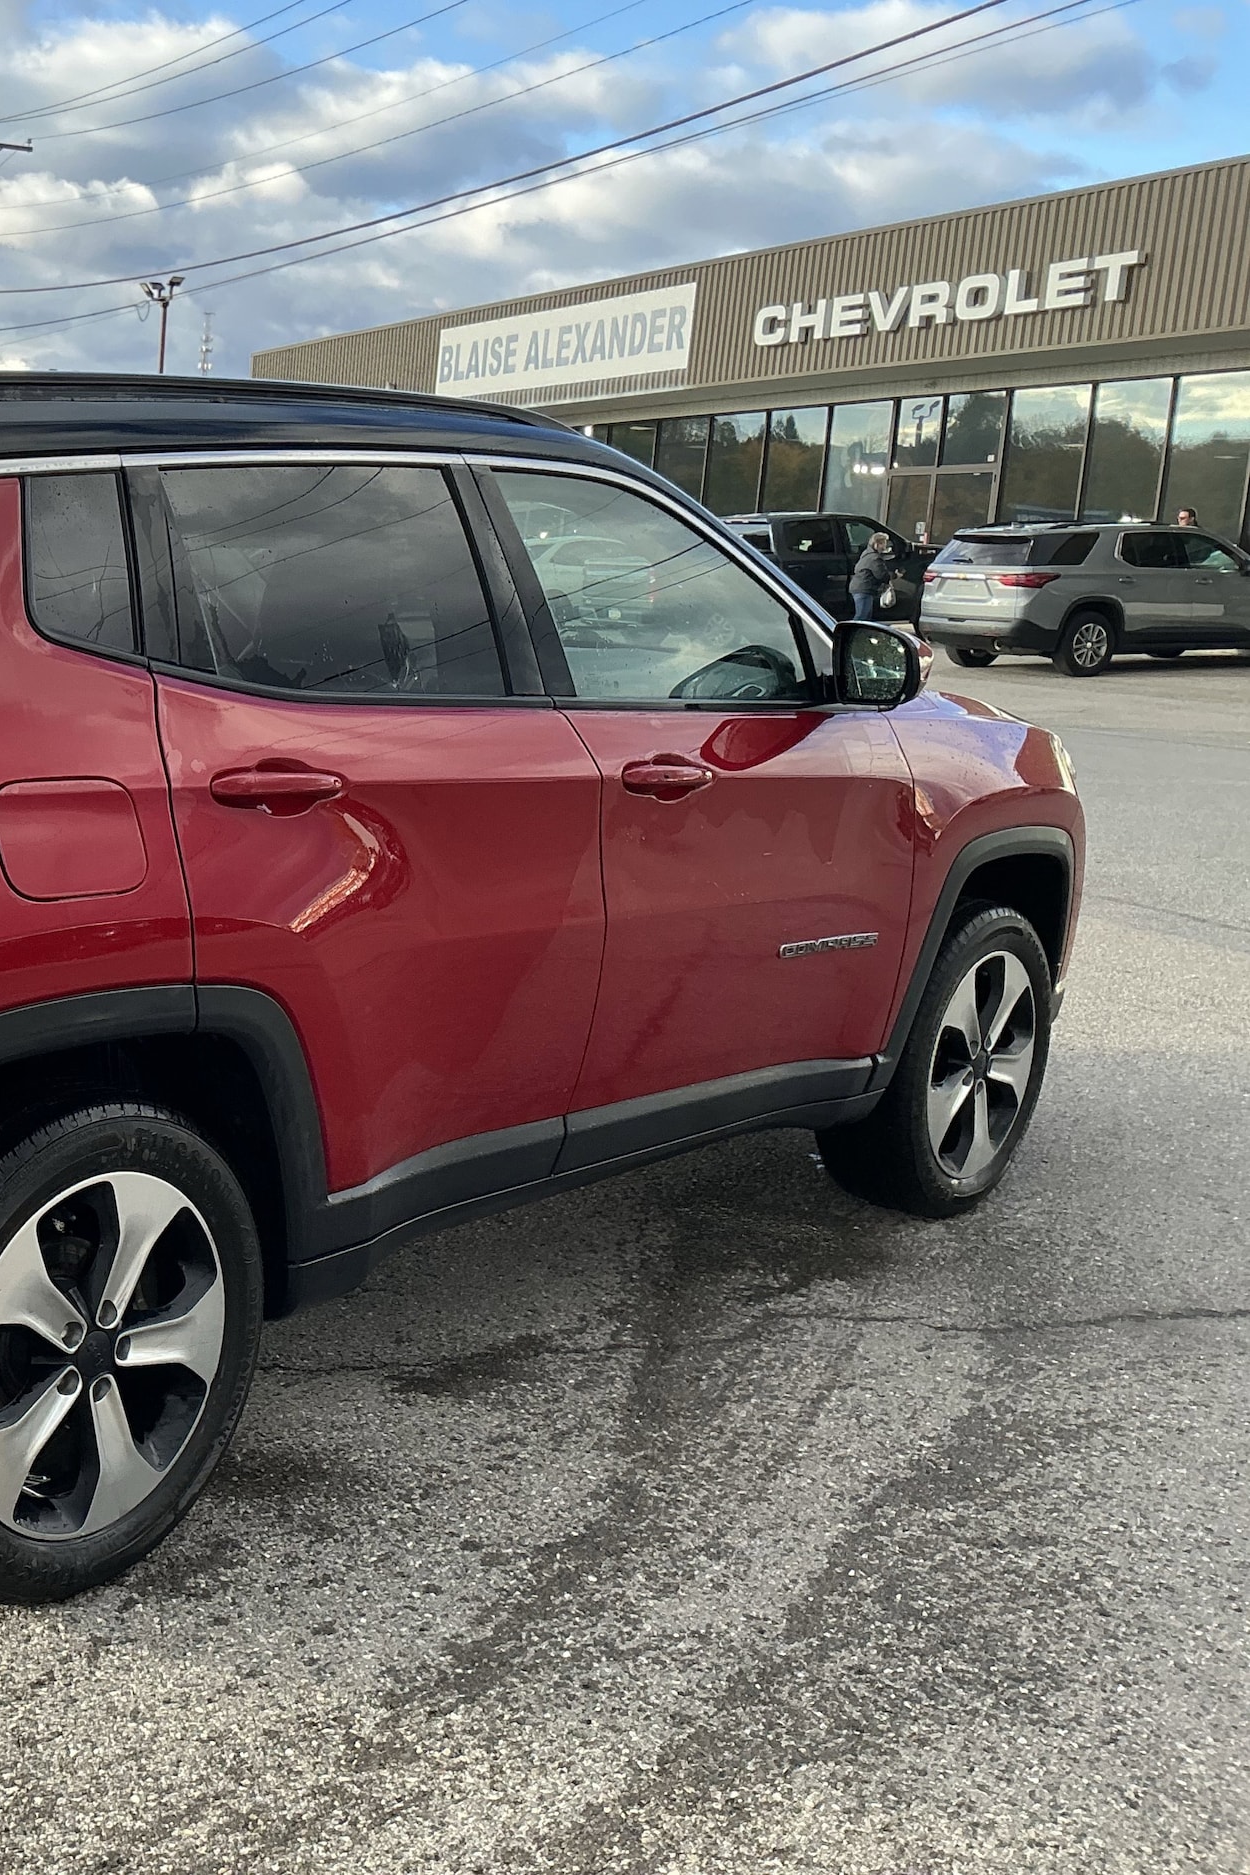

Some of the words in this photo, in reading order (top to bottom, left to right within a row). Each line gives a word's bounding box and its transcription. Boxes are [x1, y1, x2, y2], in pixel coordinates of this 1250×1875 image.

[753, 249, 1142, 347] CHEVROLET
[438, 333, 519, 384] BLAISE
[523, 304, 687, 372] ALEXANDER
[779, 932, 879, 958] COMPASS
